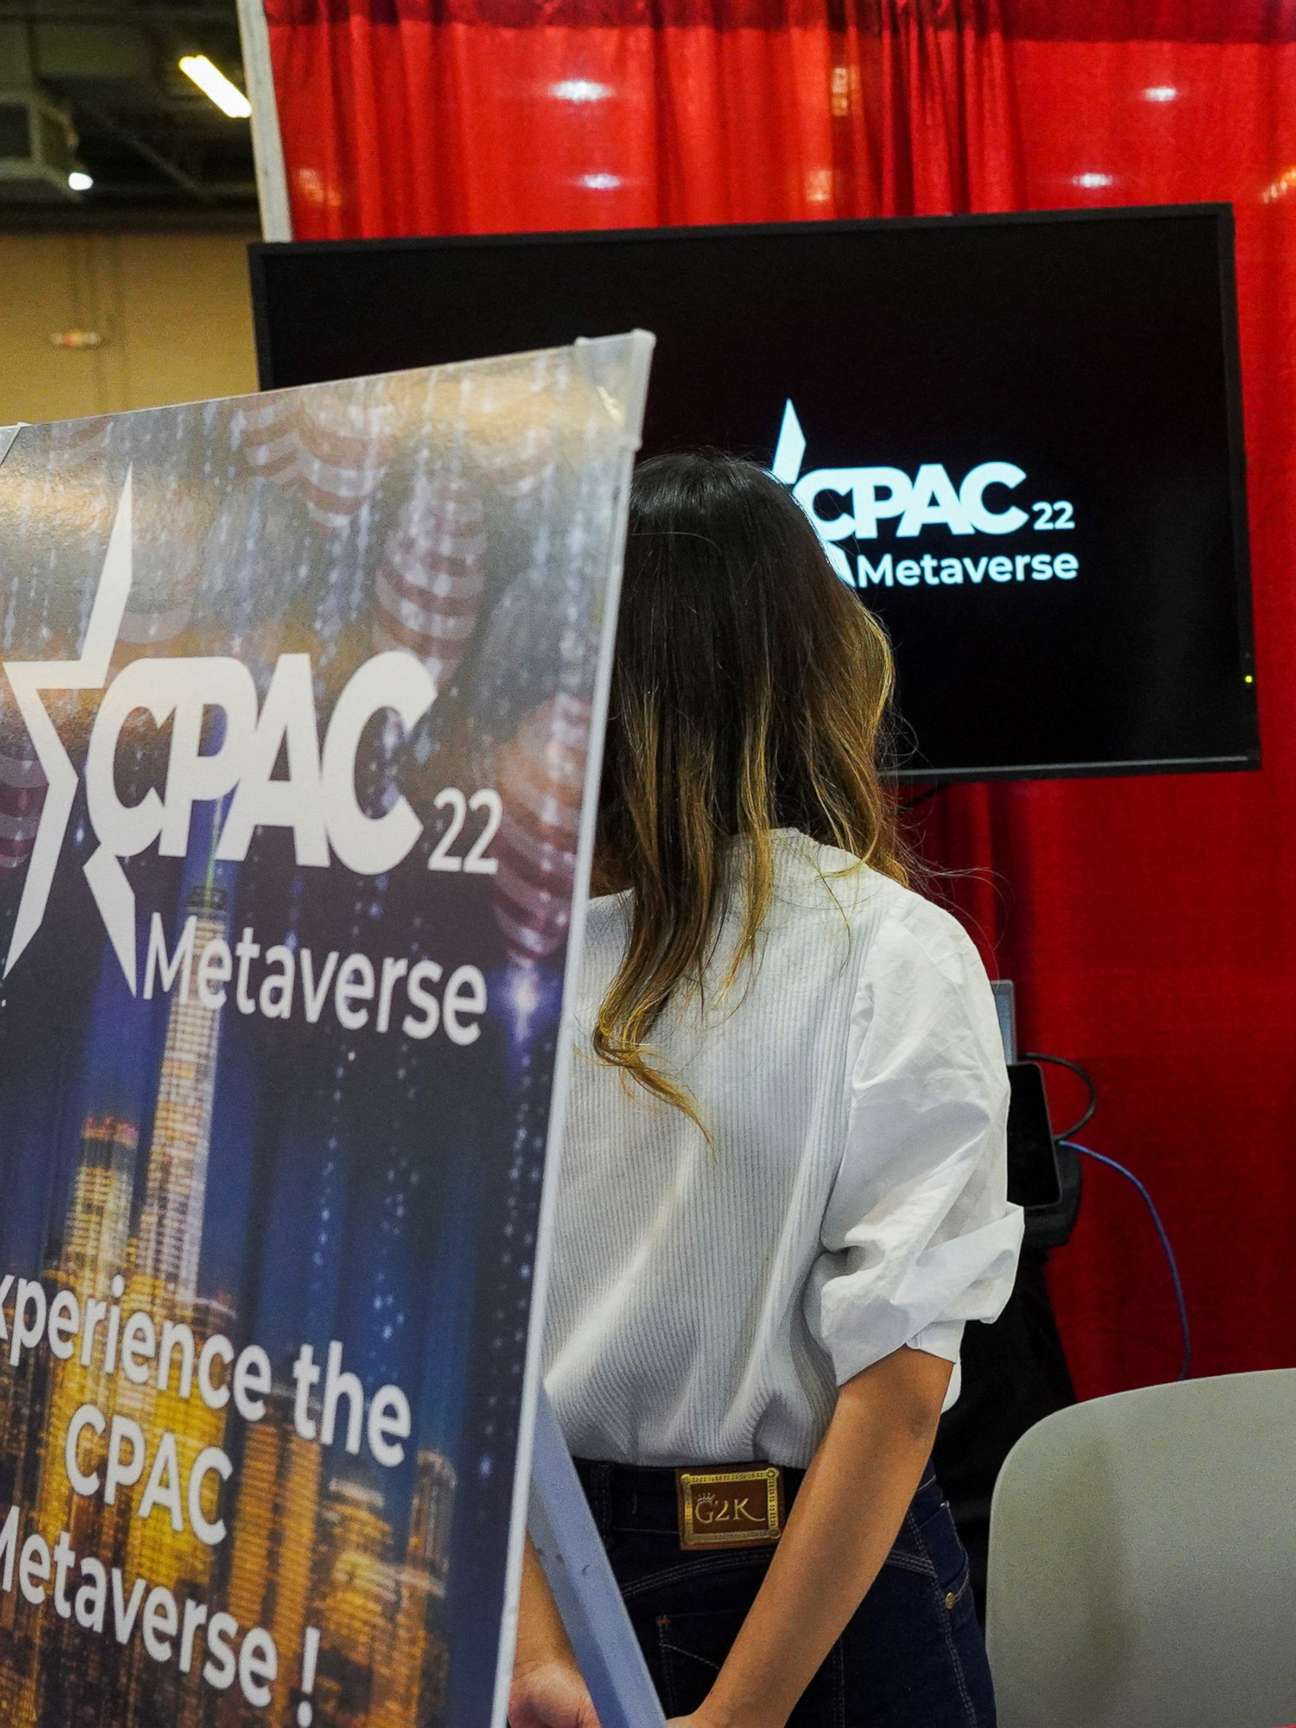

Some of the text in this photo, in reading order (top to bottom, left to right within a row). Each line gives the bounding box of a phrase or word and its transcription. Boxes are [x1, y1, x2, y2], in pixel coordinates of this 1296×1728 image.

[792, 461, 1076, 541] CPAC 22
[857, 552, 1079, 587] Metaverse
[86, 651, 501, 875] CPAC 22
[143, 912, 487, 1045] Metaverse
[0, 1274, 411, 1467] xperience the
[65, 1405, 233, 1545] CPAC
[695, 1498, 766, 1524] G2K
[297, 1627, 320, 1728] !
